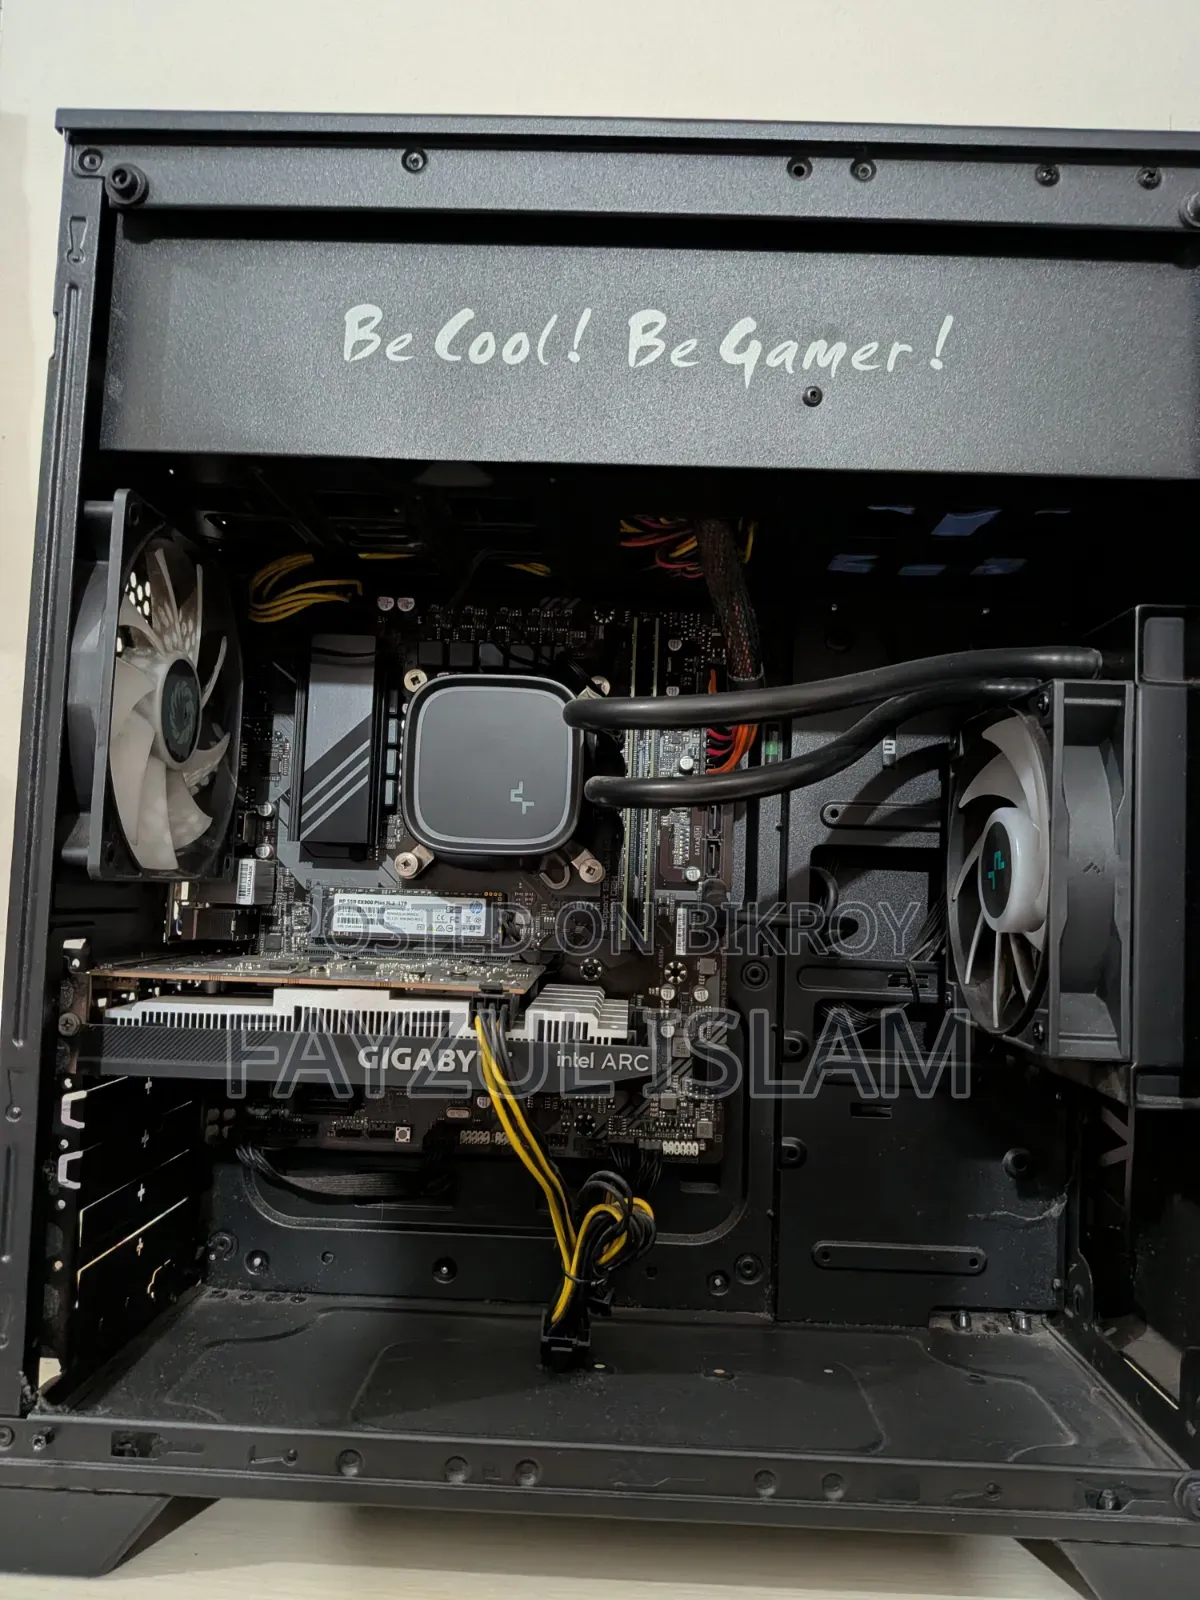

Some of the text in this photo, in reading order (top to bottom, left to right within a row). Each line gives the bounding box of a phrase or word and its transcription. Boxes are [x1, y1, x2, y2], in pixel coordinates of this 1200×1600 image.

[343, 303, 413, 362] Be
[434, 307, 592, 365] Cool!
[628, 308, 698, 368] Be
[357, 1046, 512, 1073] GIGABY
[556, 1050, 650, 1072] intel ARC
